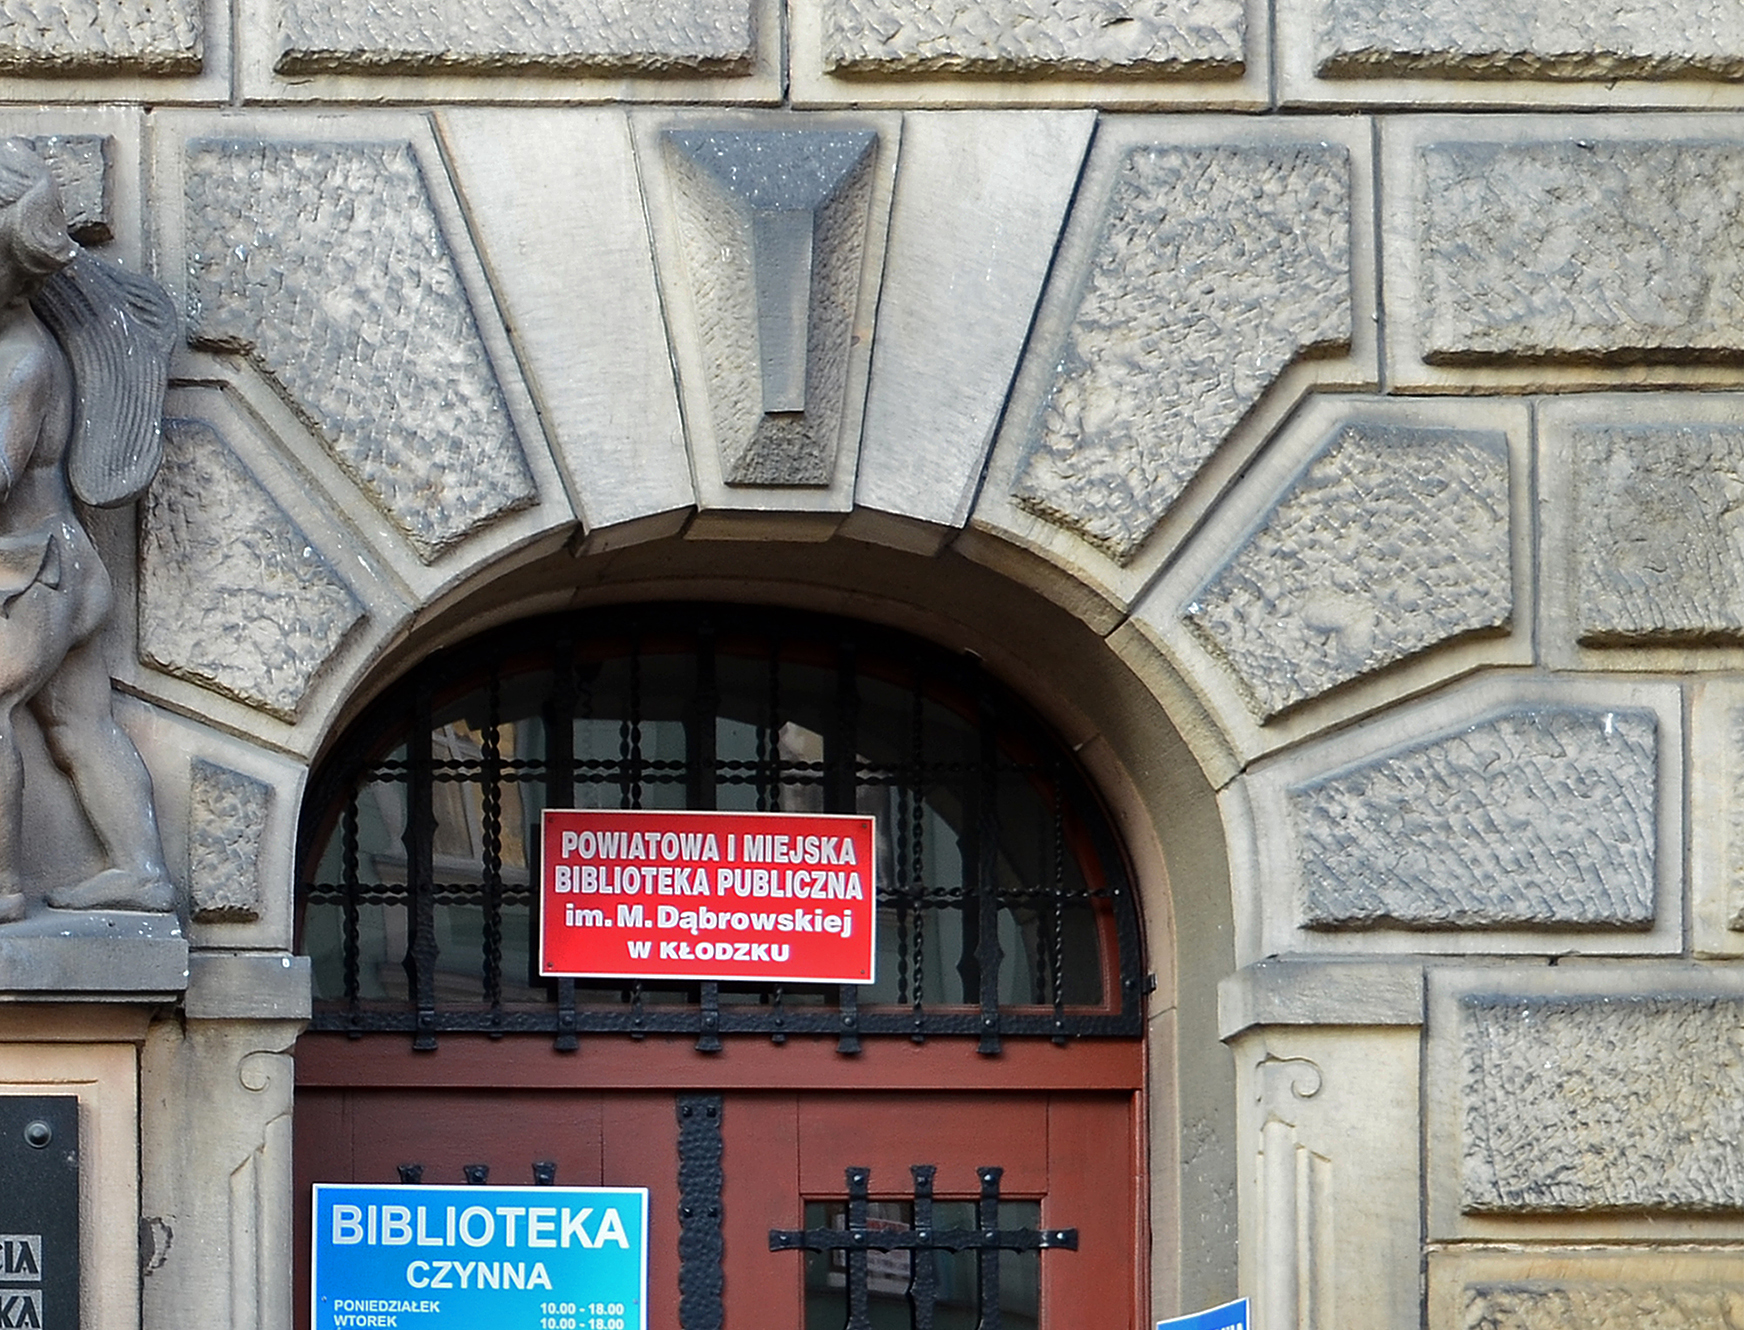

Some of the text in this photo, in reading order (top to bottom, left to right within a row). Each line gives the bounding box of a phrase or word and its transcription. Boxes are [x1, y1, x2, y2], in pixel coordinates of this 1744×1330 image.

[562, 831, 855, 864] POWIATOWA I MIEJSKA
[555, 866, 862, 899] BIBLIOTEKA PUBLICZNA
[565, 904, 852, 937] im. M. Dąbrowskiej
[660, 942, 789, 962] KŁODZKU
[332, 1205, 630, 1248] BIBLIOTEKA
[406, 1261, 552, 1290] CZYNNA
[334, 1300, 440, 1313] PONIEDZIAŁEK
[540, 1303, 576, 1315] 10.00
[588, 1303, 624, 1315] 18.00
[334, 1315, 397, 1327] WTOREK
[540, 1318, 576, 1330] 10.00
[588, 1318, 624, 1330] 18.00
